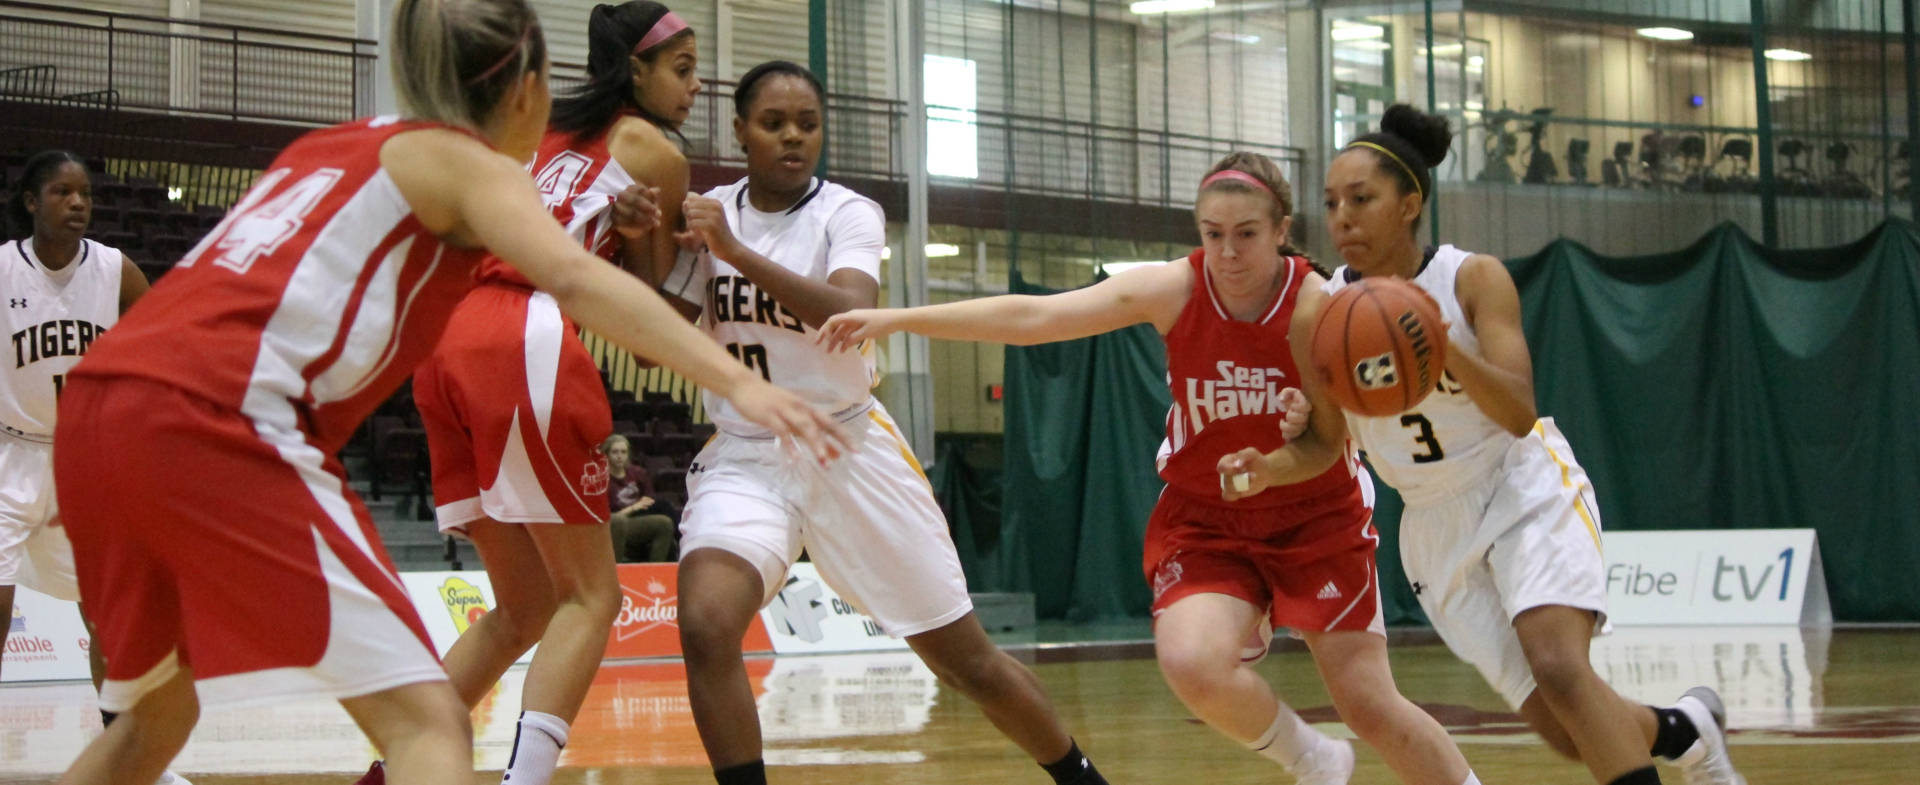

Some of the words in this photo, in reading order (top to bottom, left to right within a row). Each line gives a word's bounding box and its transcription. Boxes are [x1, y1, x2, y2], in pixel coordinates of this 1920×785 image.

[524, 149, 594, 213] 4
[1401, 413, 1445, 464] 3
[447, 587, 484, 615] Super
[1606, 563, 1678, 596] Fibe
[1712, 547, 1795, 602] tv1
